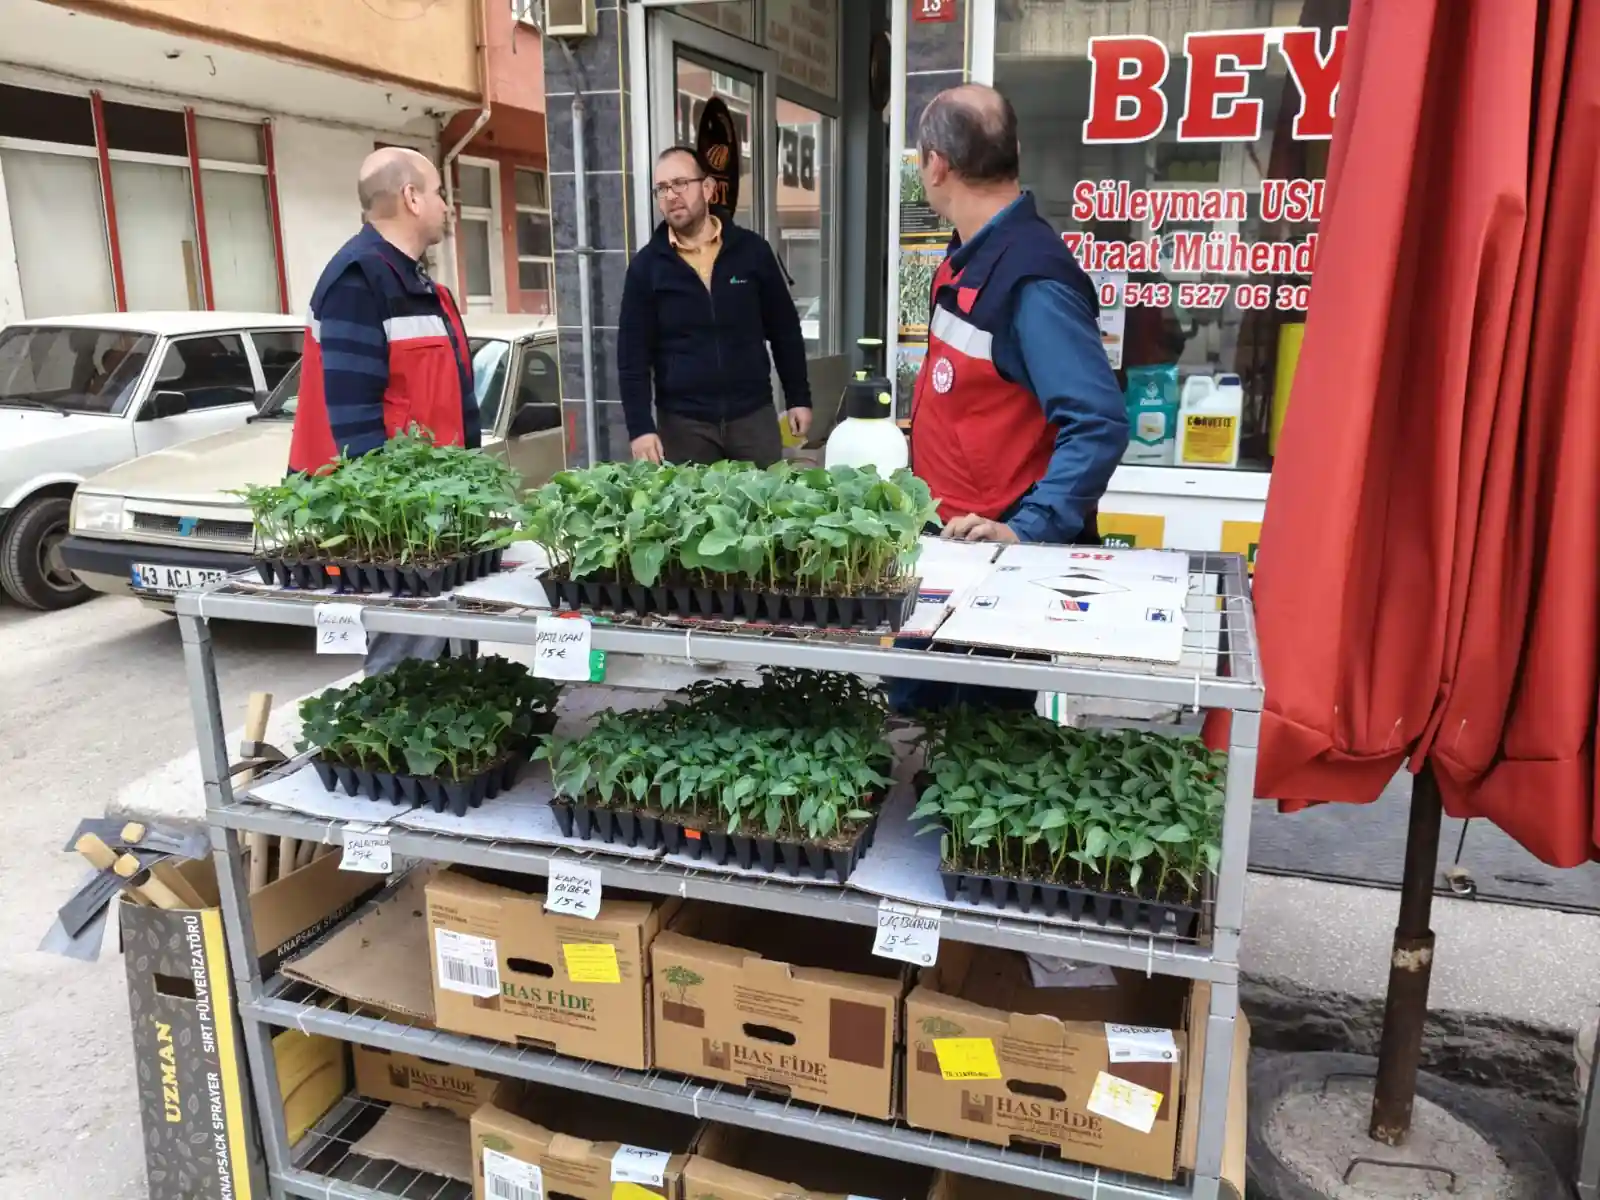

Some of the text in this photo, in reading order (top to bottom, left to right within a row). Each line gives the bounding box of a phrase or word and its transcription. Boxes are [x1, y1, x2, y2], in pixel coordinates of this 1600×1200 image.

[1083, 27, 1348, 144] BEY
[1072, 180, 1248, 230] Süleyman
[1062, 232, 1318, 274] Ziraat Mühend
[1100, 283, 1311, 311] 0 543 527 06 30
[142, 566, 158, 585] 43
[322, 631, 336, 645] 15
[541, 647, 557, 659] 15
[554, 896, 574, 906] 15
[884, 933, 900, 945] 15
[501, 981, 596, 1013] HAS FİDE
[200, 1023, 216, 1053] SIRT
[155, 1021, 181, 1123] UZMAN
[732, 1044, 828, 1078] HAS FİDE
[206, 1071, 224, 1131] SPRAYER
[996, 1097, 1103, 1132] HAS FİDE
[213, 1133, 232, 1200] KNAPSACK
